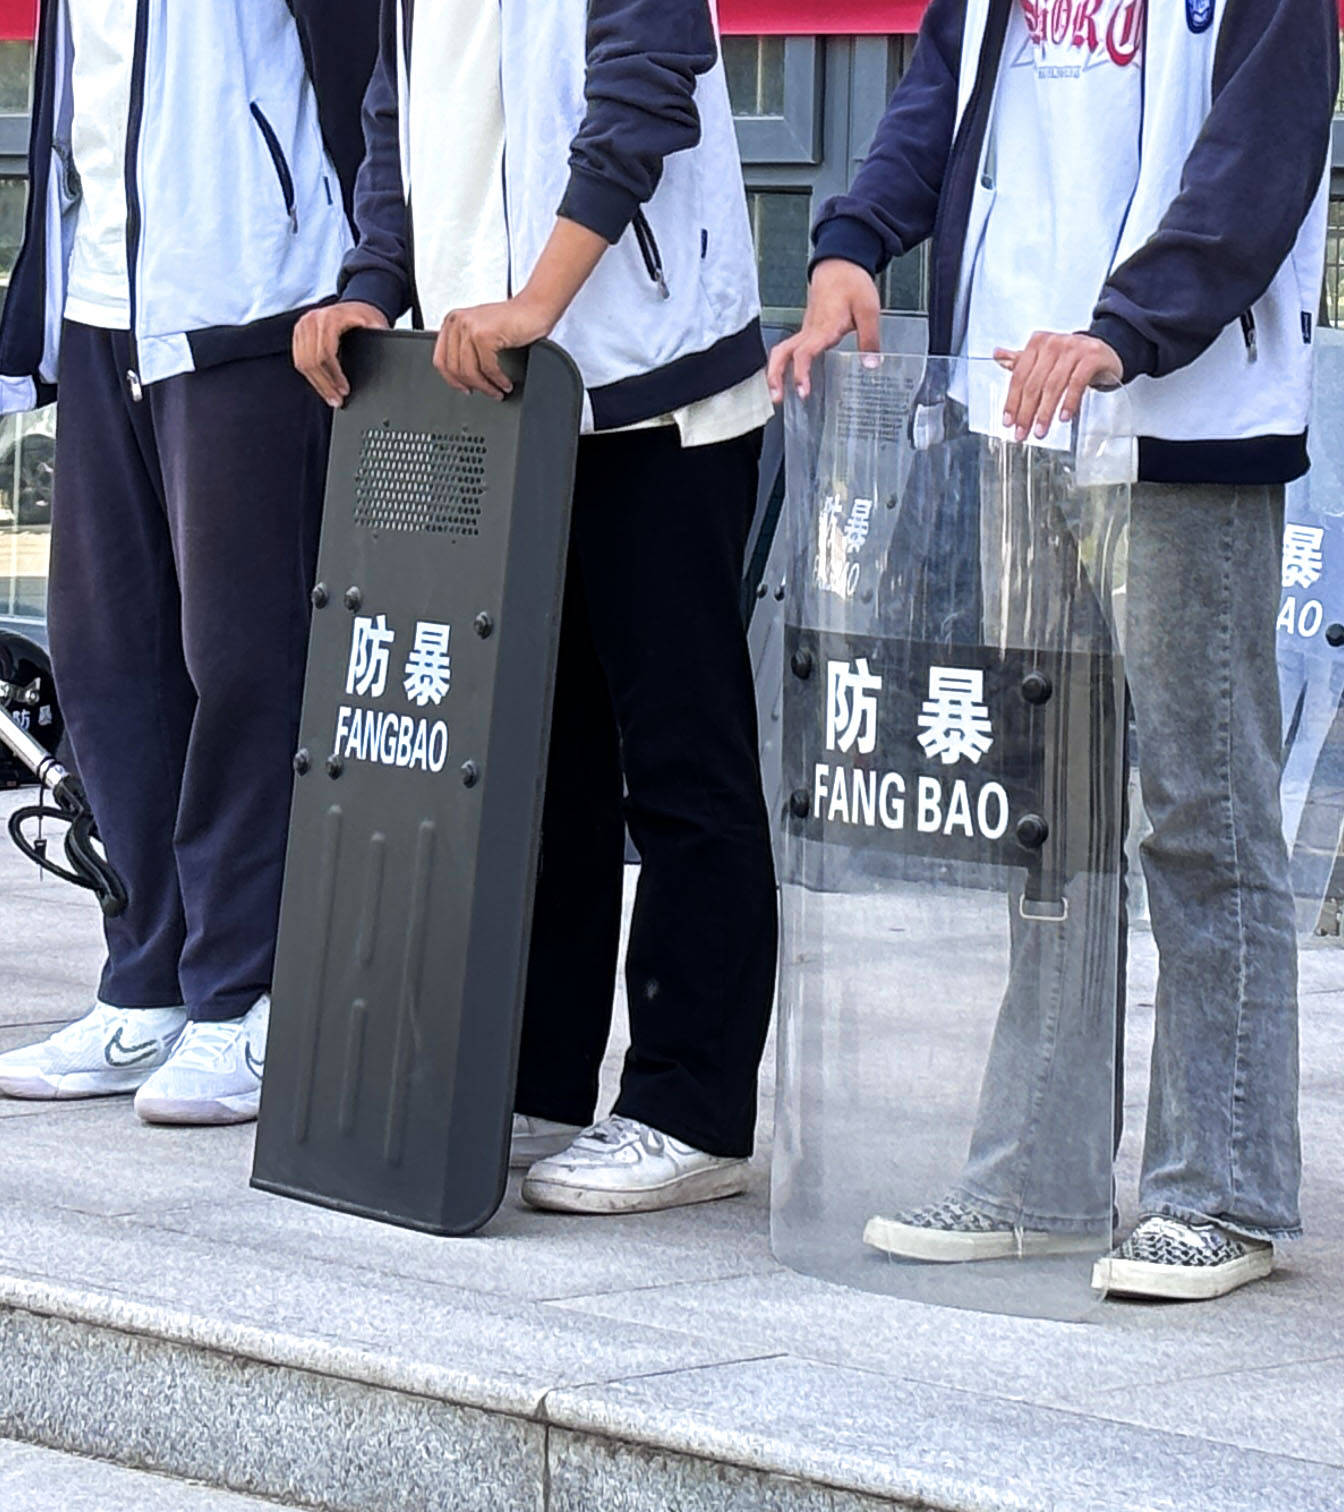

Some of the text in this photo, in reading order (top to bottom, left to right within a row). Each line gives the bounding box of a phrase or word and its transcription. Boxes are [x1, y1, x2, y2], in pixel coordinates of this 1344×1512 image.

[1282, 523, 1325, 589] 暴
[345, 614, 452, 707] 防暴
[334, 705, 449, 773] FANGBAO
[825, 657, 995, 765] 防暴
[813, 762, 1010, 840] FANG BAO
